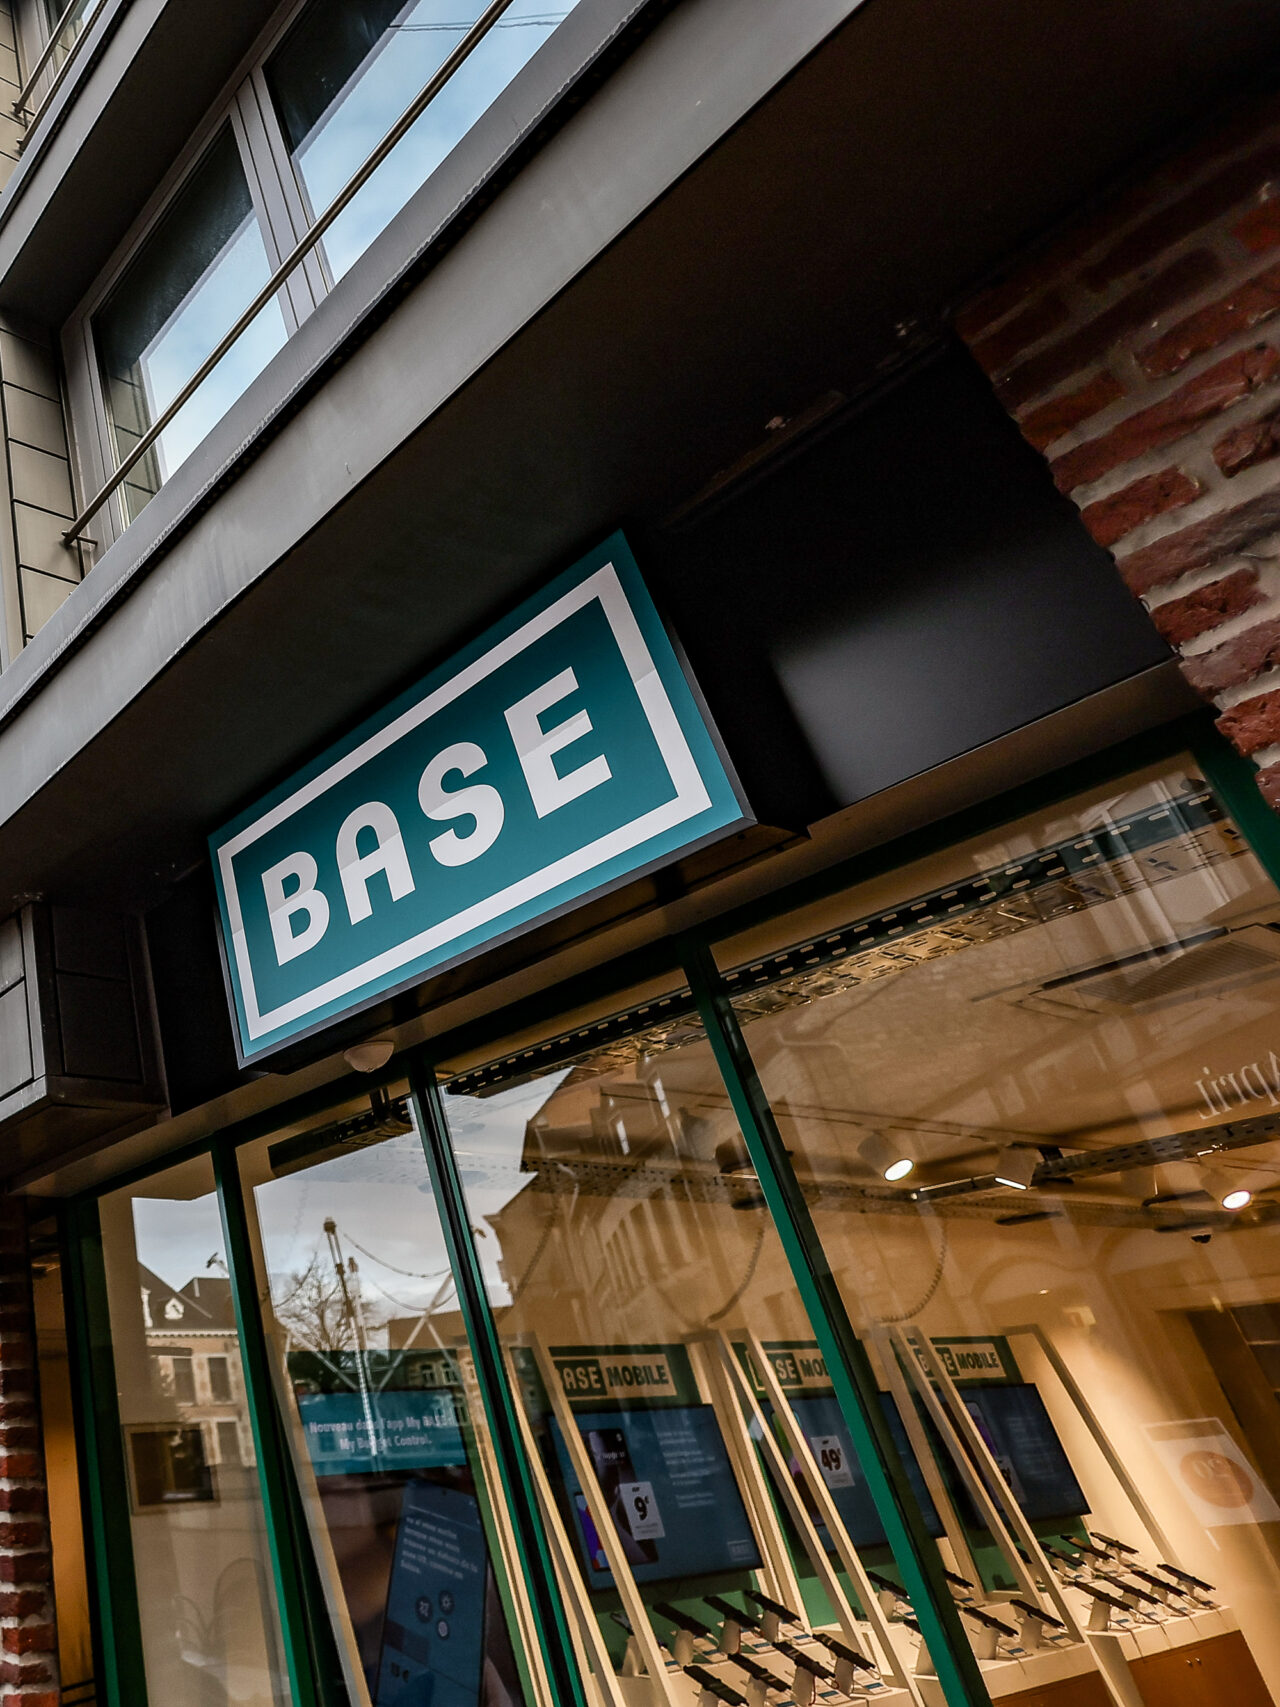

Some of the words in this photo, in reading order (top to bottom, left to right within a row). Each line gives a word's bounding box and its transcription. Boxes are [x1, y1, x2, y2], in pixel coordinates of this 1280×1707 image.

[261, 666, 614, 968] BASE
[956, 1352, 1000, 1370] MOBILE
[563, 1366, 601, 1390] ASE
[605, 1365, 670, 1388] MOBILE
